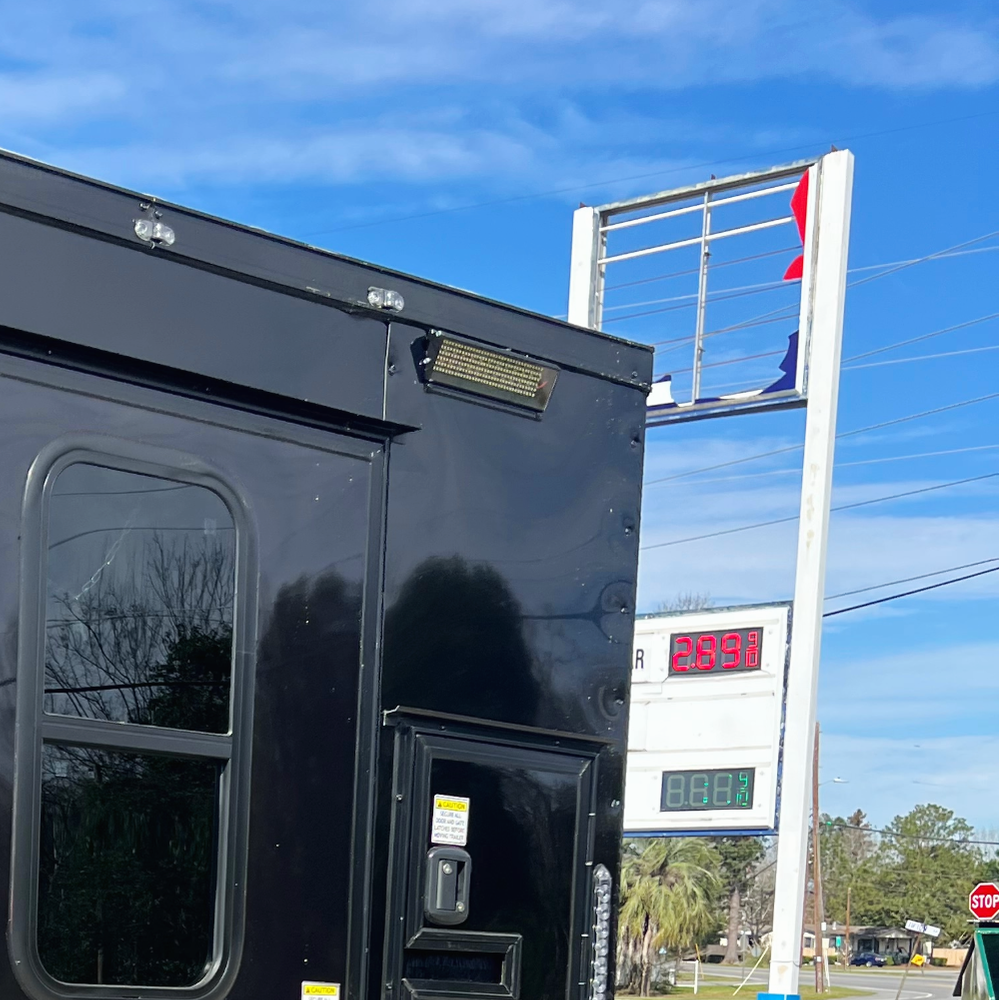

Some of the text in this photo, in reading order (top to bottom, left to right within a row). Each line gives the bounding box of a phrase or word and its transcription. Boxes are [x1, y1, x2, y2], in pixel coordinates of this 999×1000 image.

[672, 632, 742, 672] 2.89
[443, 801, 466, 810] CAUTION
[971, 894, 999, 909] STOP
[311, 986, 335, 994] CAUTION
